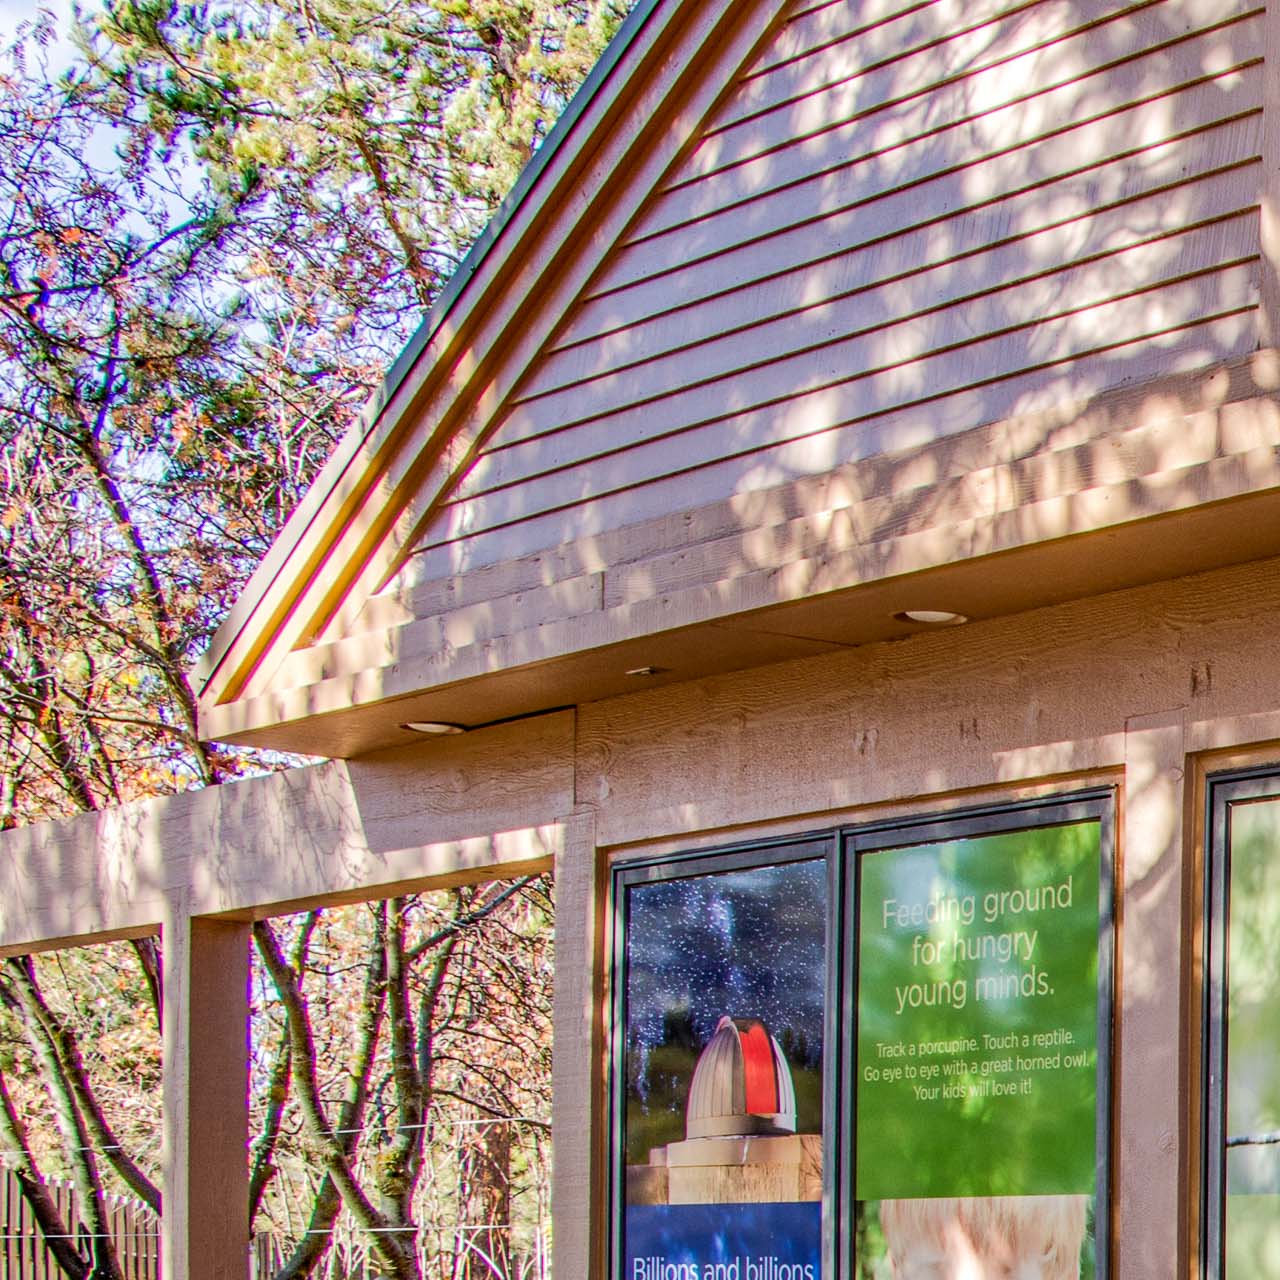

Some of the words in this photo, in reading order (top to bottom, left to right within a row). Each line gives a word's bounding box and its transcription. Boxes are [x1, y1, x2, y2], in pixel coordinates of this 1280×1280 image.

[883, 892, 975, 928] Feeding
[984, 875, 1073, 922] ground
[913, 936, 946, 966] for
[952, 930, 1038, 963] hungry
[896, 980, 967, 1014] young
[975, 964, 1054, 1001] minds.
[876, 1041, 906, 1059] Track
[908, 1045, 916, 1056] a
[919, 1036, 980, 1057] porcupine.
[982, 1033, 1019, 1049] Touch
[1021, 1035, 1029, 1047] a
[1032, 1028, 1075, 1048] reptile.
[864, 1066, 880, 1082] Go
[882, 1067, 902, 1083] eye
[905, 1065, 917, 1079] to
[919, 1064, 939, 1080] eye
[942, 1059, 968, 1076] with
[971, 1063, 977, 1074] a
[981, 1056, 1012, 1076] great
[1016, 1052, 1060, 1070] horned
[1064, 1052, 1089, 1068] owl.
[914, 1084, 939, 1100] Your
[942, 1082, 966, 1099] kids
[968, 1080, 989, 1098] will
[991, 1079, 1016, 1097] love
[1020, 1078, 1032, 1095] it!
